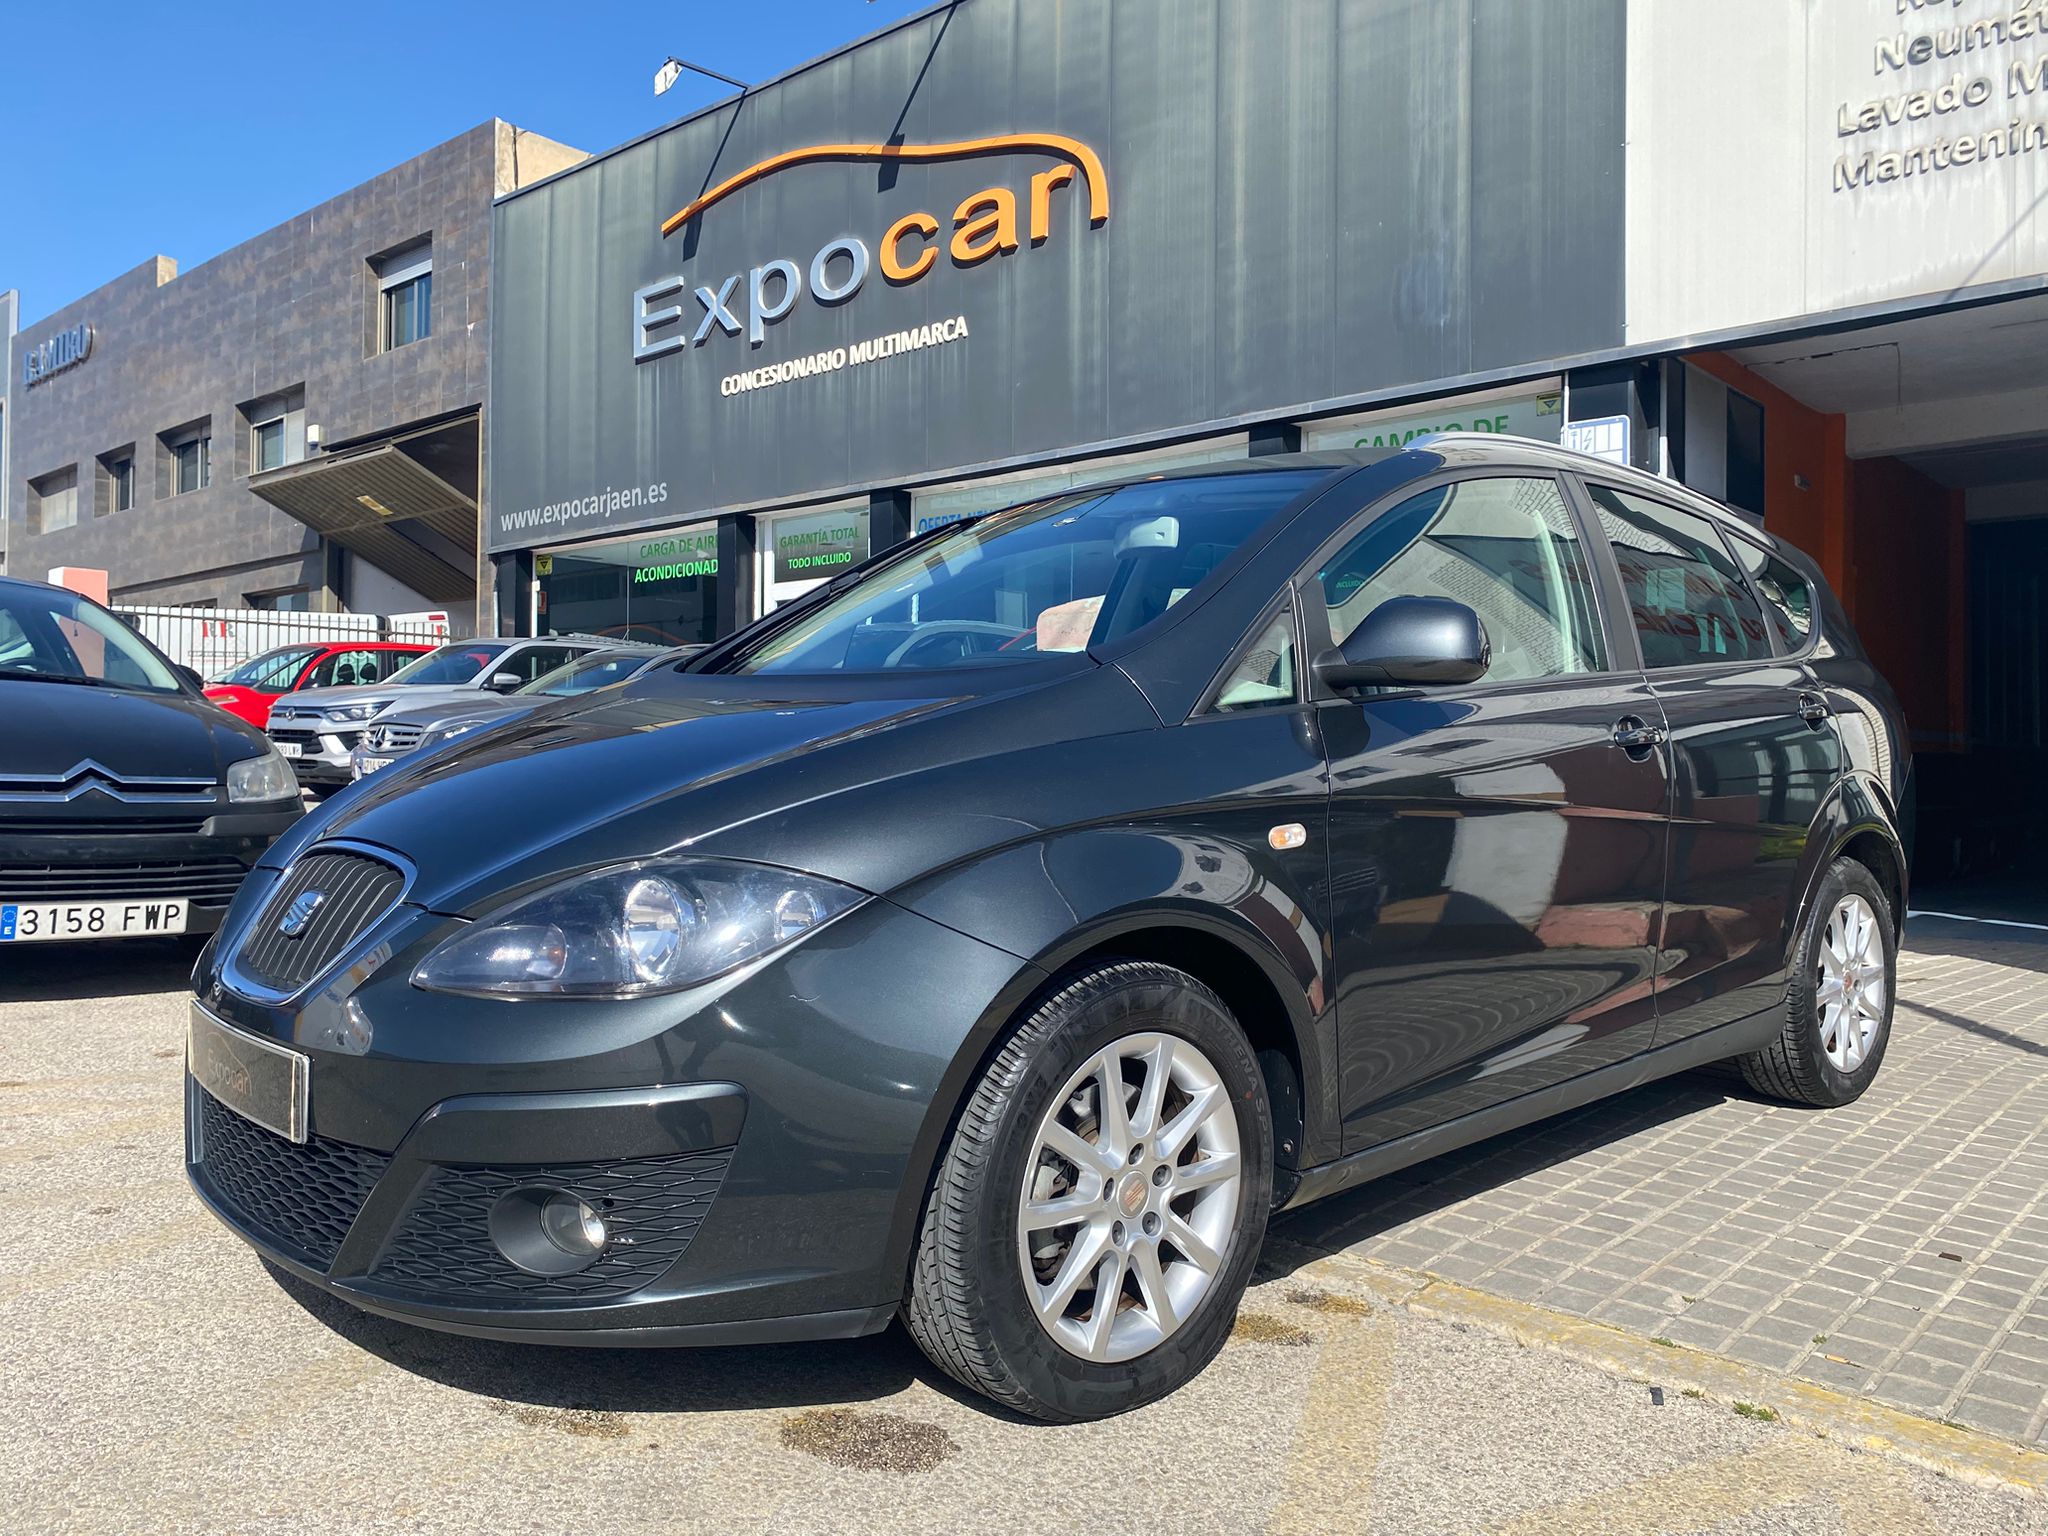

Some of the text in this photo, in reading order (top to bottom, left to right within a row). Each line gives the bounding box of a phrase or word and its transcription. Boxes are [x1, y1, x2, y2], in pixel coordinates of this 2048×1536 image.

[1837, 72, 1993, 138] Lavado
[632, 162, 1080, 362] Expocar
[720, 315, 969, 397] CONCESIONARIO MULTIMARCA
[500, 481, 668, 532] www.expocarjaen.es
[639, 534, 718, 558] CARGA DE AIR
[780, 525, 860, 548] GARANTÍA TOTAL
[787, 551, 852, 570] TODO INCLUIDO
[19, 906, 106, 935] 3158
[122, 903, 182, 932] FWP
